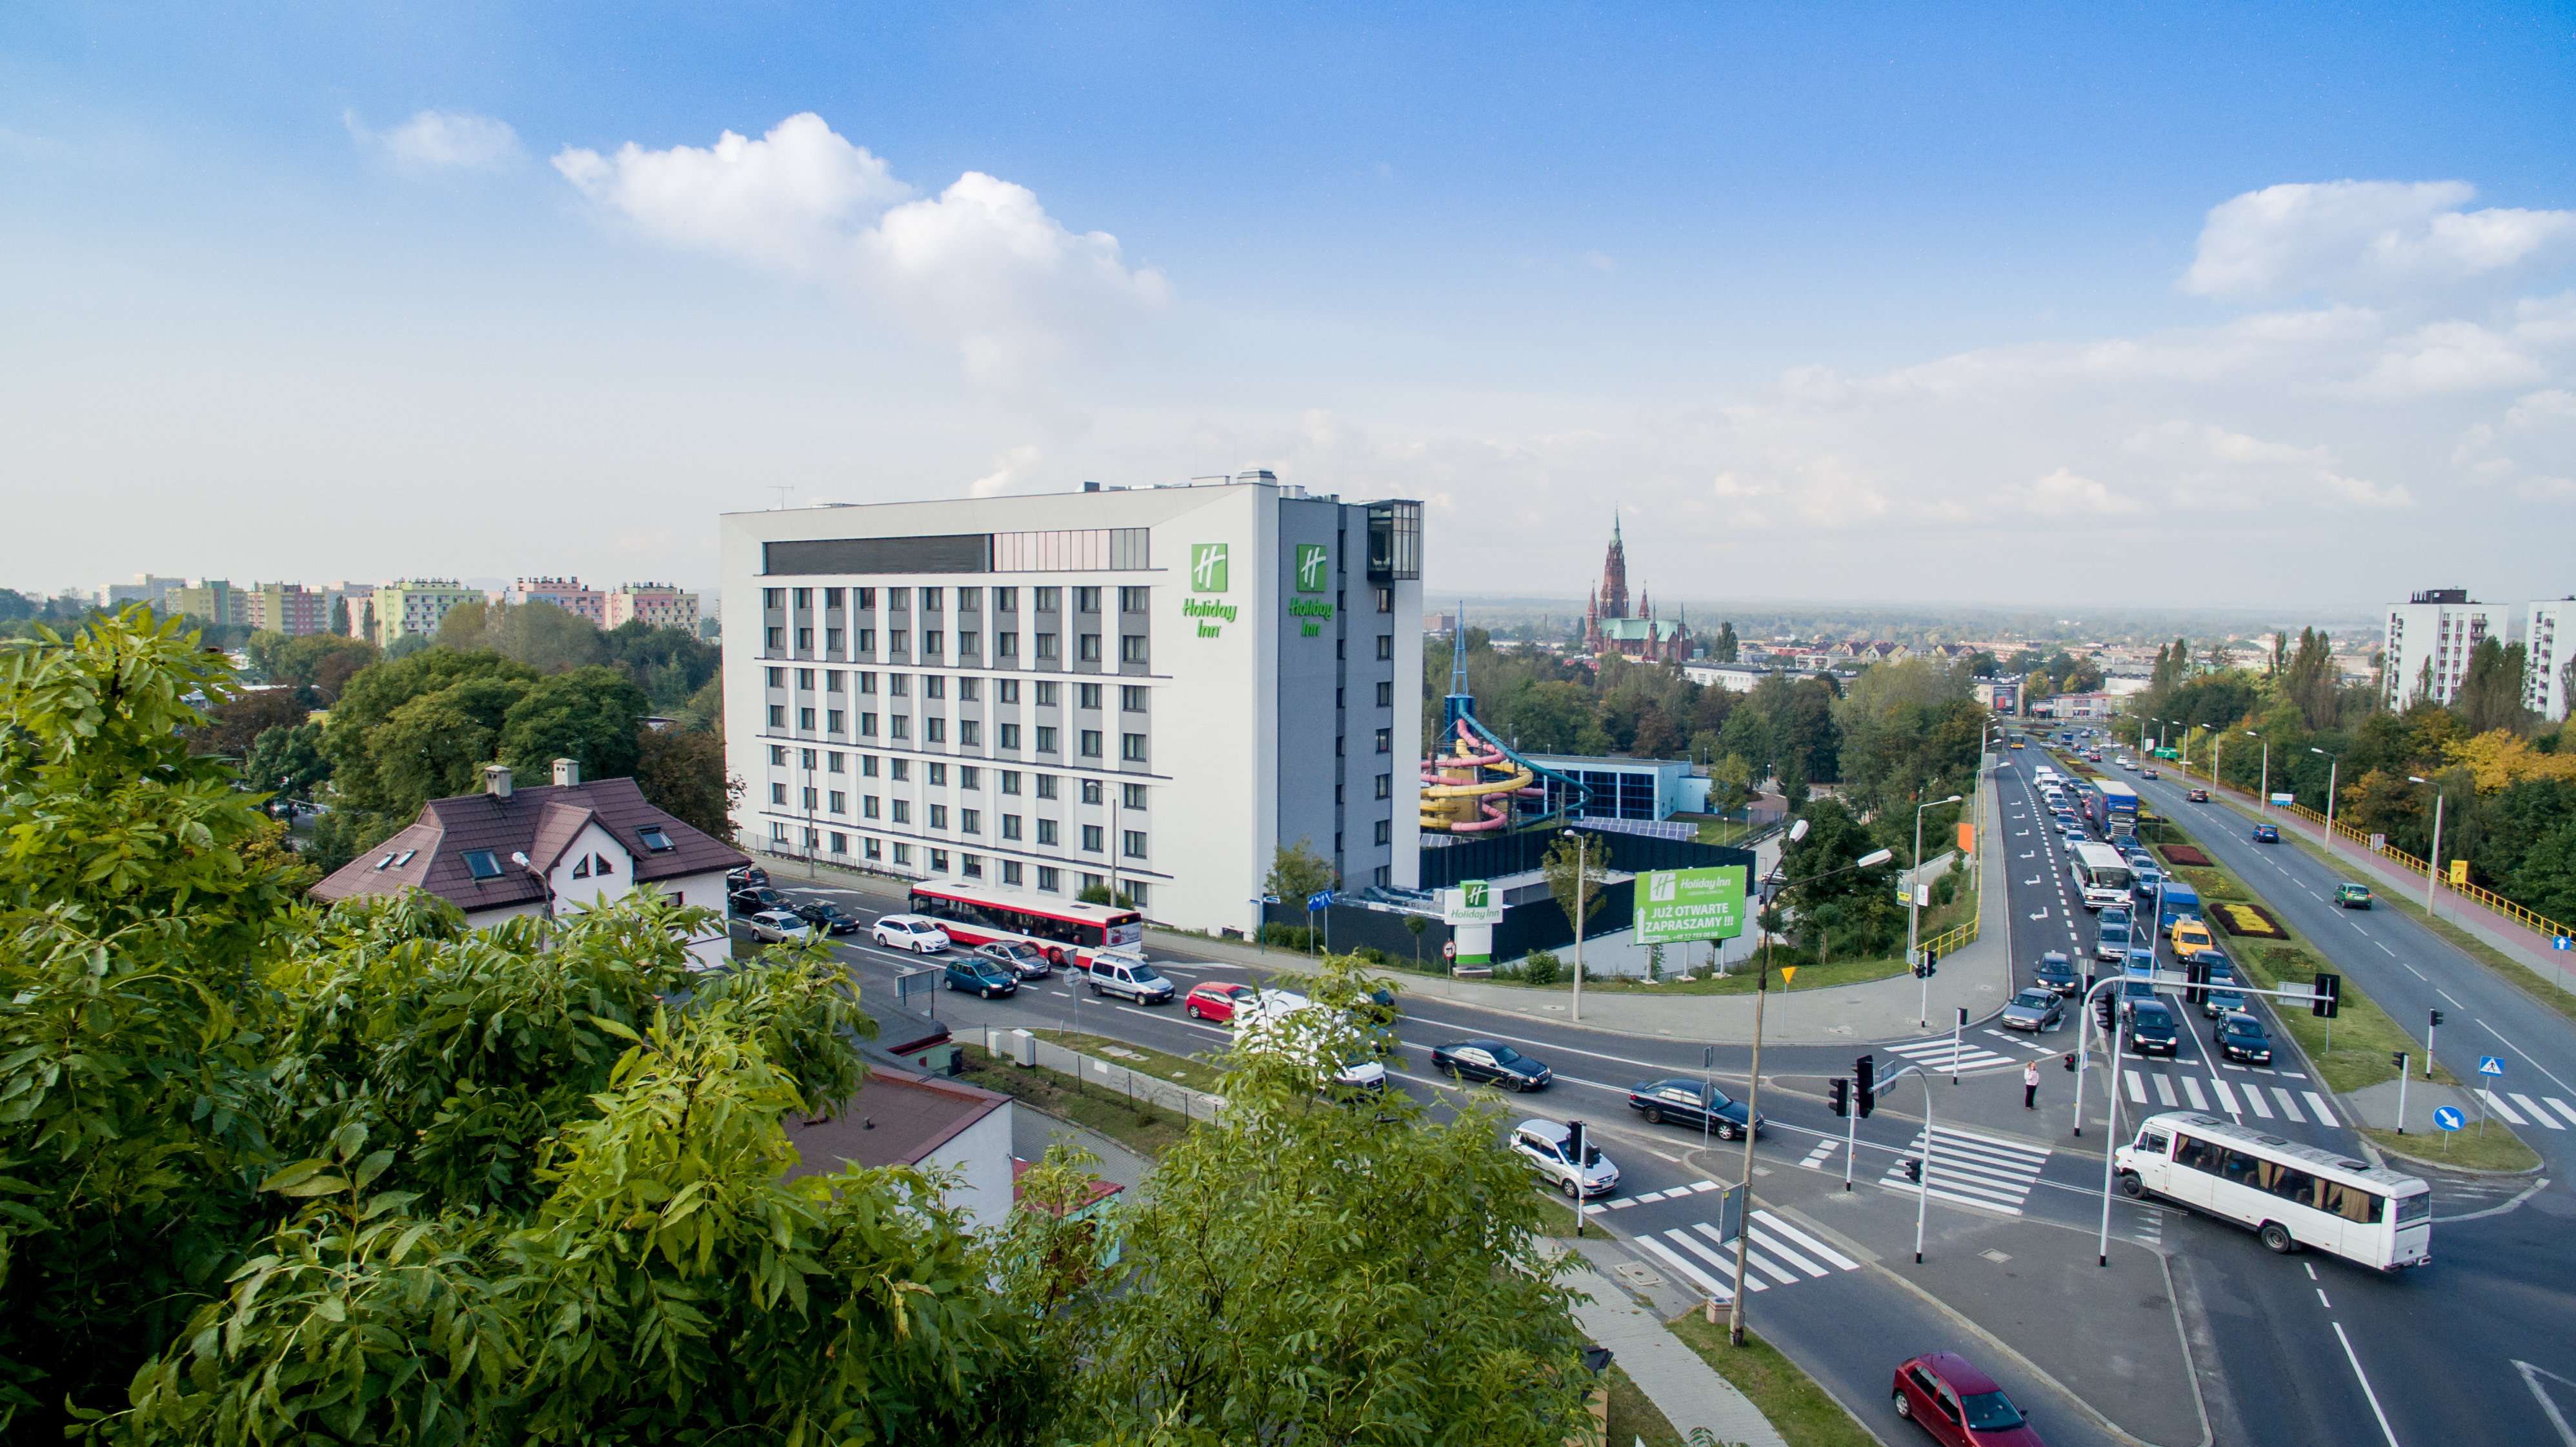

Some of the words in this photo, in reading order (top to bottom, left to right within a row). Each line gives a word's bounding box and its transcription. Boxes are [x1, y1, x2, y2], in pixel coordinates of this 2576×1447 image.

[1182, 598, 1237, 622] Holiday
[1289, 597, 1334, 620] Holiday
[1196, 619, 1220, 638] Inn
[1301, 618, 1320, 636] Inn
[1680, 877, 1716, 889] Holiday
[1716, 876, 1731, 886] Inn
[1451, 909, 1485, 920] Holiday
[1486, 908, 1499, 917] Inn
[1651, 905, 1673, 918] JUŻ
[1675, 903, 1729, 916] OTWARTE
[1645, 916, 1722, 933] ZAPRASZAMY
[1724, 915, 1734, 926] !!!
